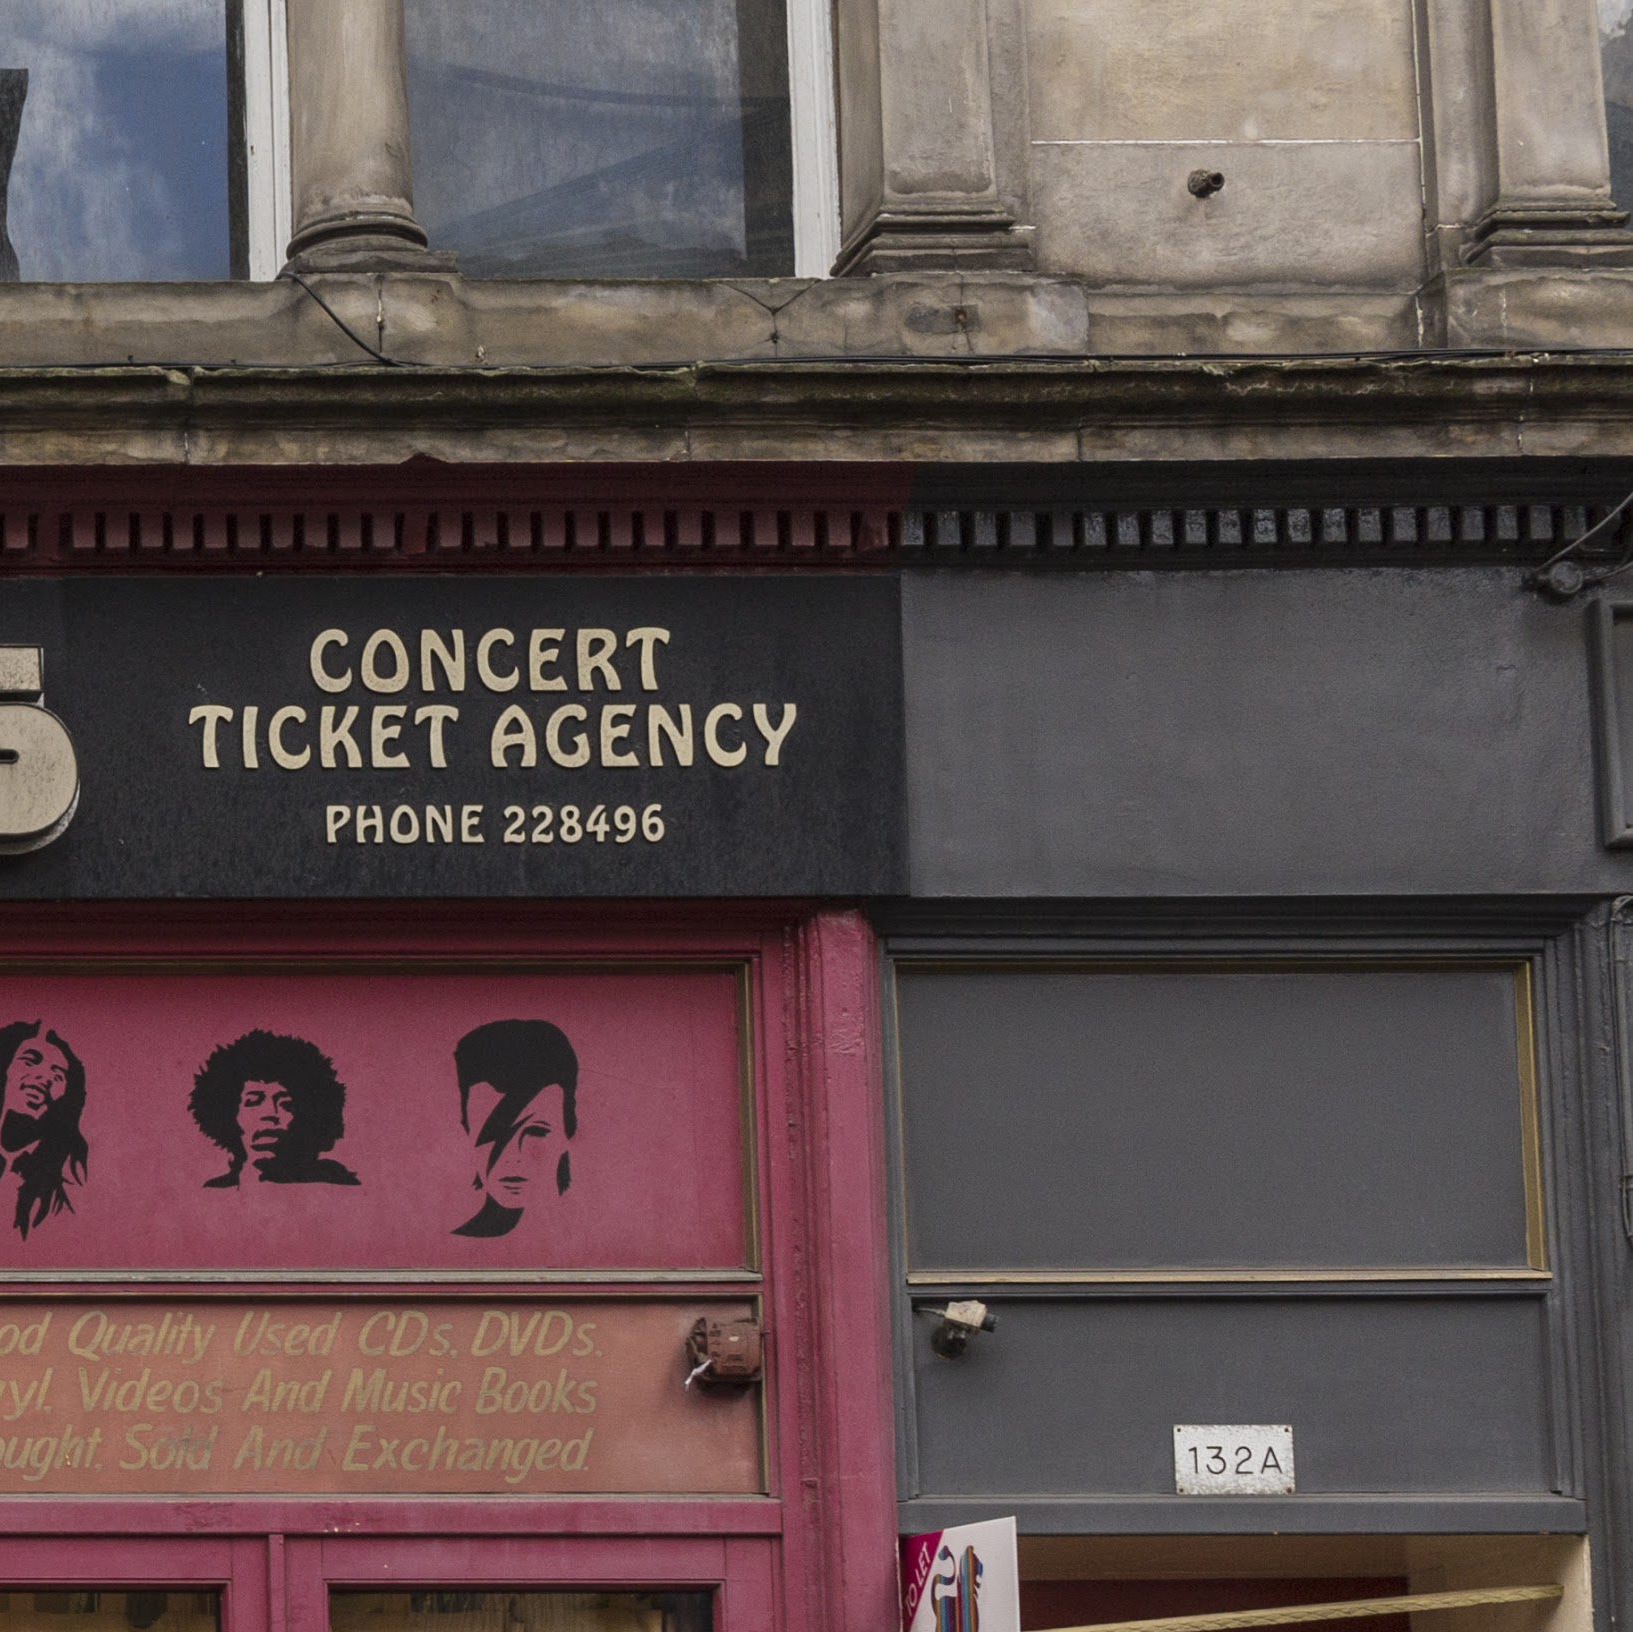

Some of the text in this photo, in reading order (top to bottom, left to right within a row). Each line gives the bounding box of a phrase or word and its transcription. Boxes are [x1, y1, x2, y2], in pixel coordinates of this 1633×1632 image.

[310, 627, 670, 693] CONCERT
[189, 704, 797, 768] TICKET AGENCY
[326, 804, 665, 843] PHONE 228496
[68, 1310, 216, 1365] Quality
[237, 1310, 342, 1356] Used
[79, 1366, 224, 1414] Videos
[241, 1368, 332, 1412] And
[340, 1367, 462, 1414] Music
[475, 1367, 598, 1414] Books
[120, 1422, 219, 1470] Sold
[235, 1424, 328, 1471] And
[1189, 1446, 1283, 1475] 132A
[904, 1541, 932, 1617] TO LET
